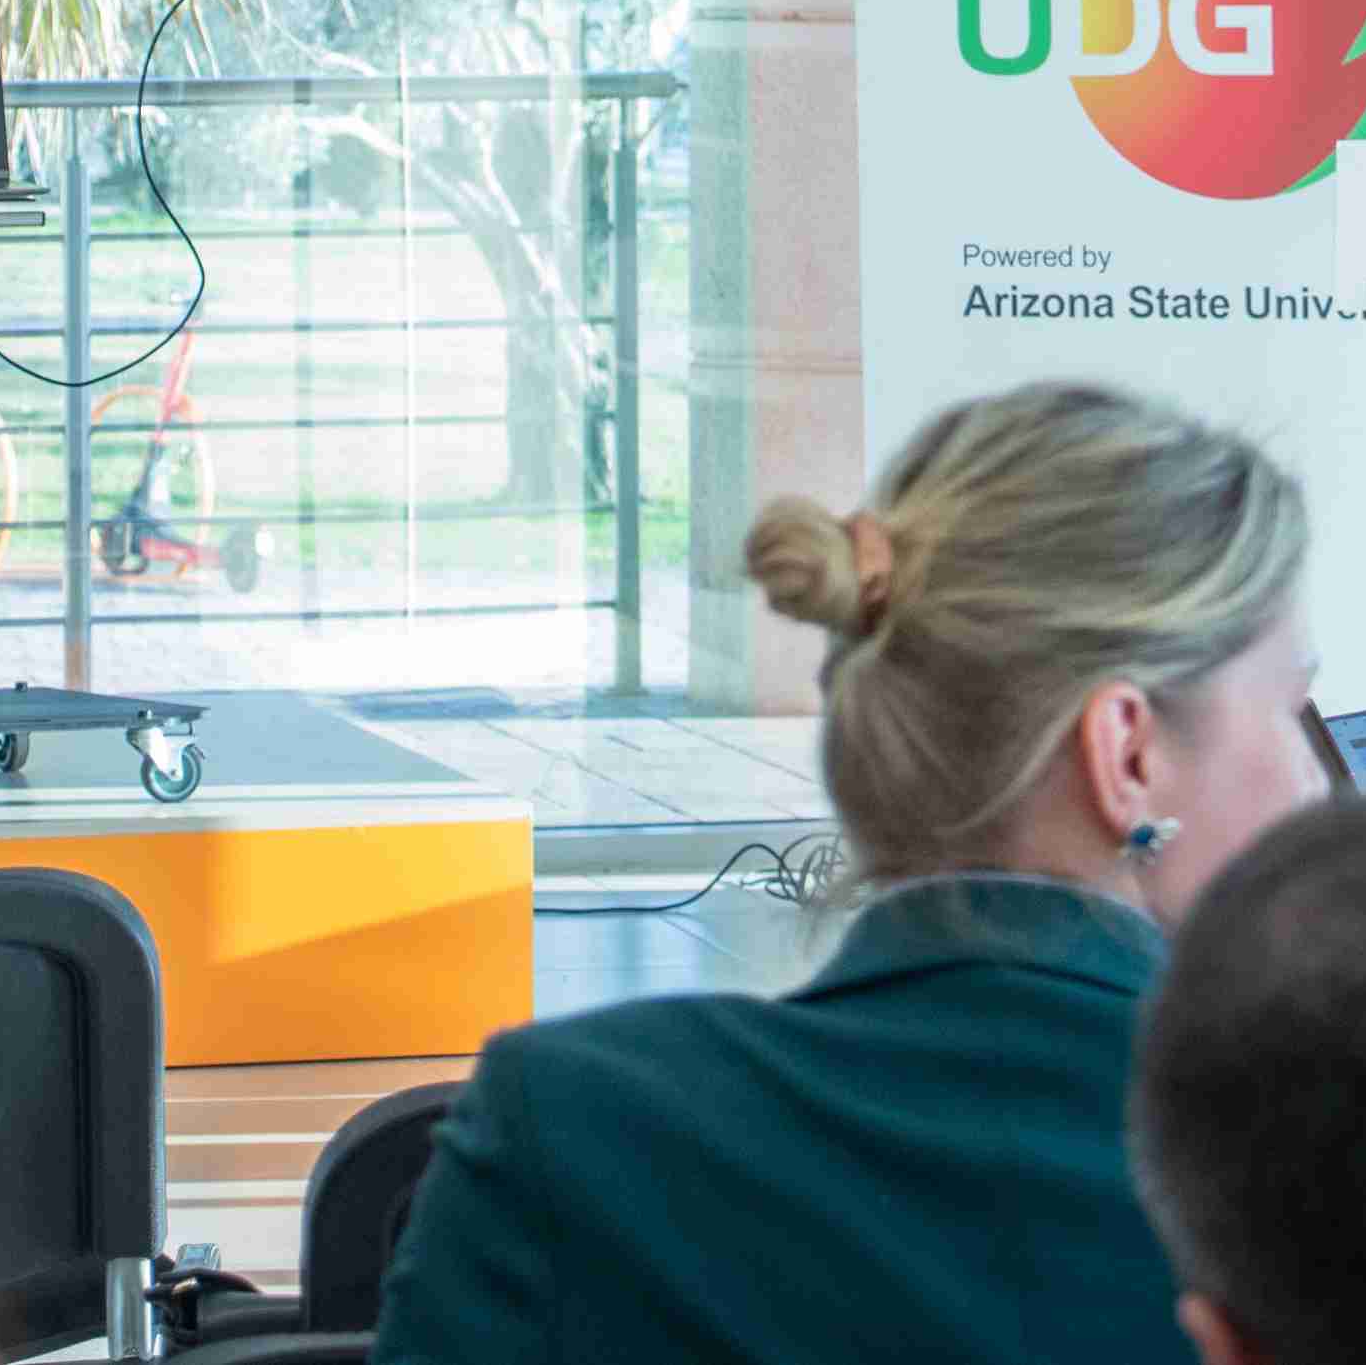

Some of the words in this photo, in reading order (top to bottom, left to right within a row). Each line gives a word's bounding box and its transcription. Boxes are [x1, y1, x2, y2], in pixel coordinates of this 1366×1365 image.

[963, 243, 1073, 268] Powered
[1082, 243, 1112, 274] by
[963, 284, 1115, 318] Arizona
[1128, 285, 1230, 319] State
